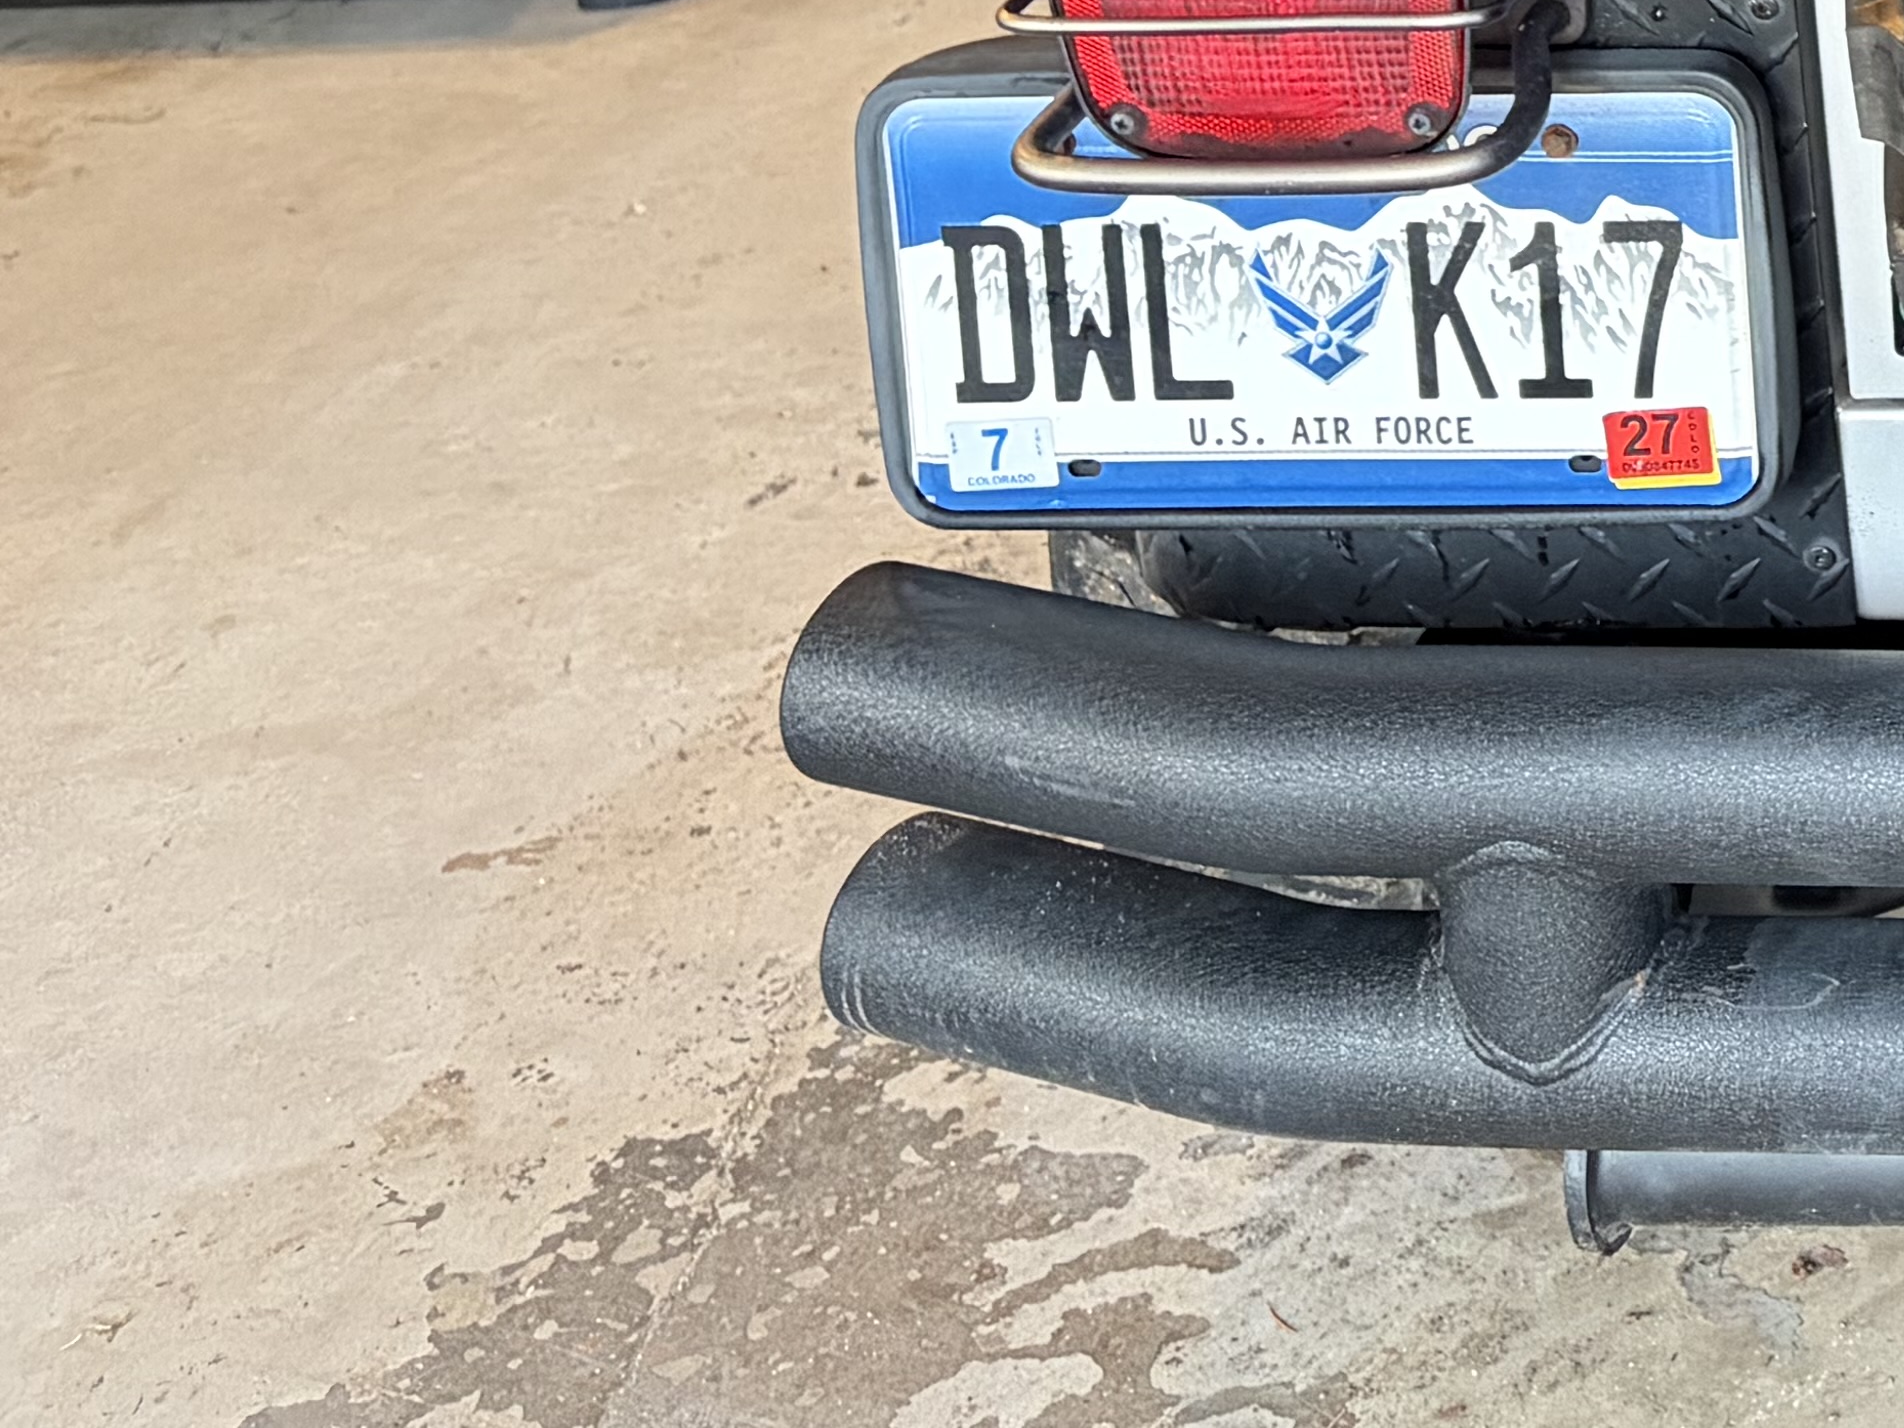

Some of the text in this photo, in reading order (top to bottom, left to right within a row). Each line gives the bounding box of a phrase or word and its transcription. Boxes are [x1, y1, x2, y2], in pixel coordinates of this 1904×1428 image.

[941, 219, 1685, 405] DWL K17
[981, 428, 1008, 471] 7
[1188, 415, 1475, 447] U.S. AIR FORCE
[1620, 413, 1679, 457] 27
[967, 473, 1036, 487] COLORADO
